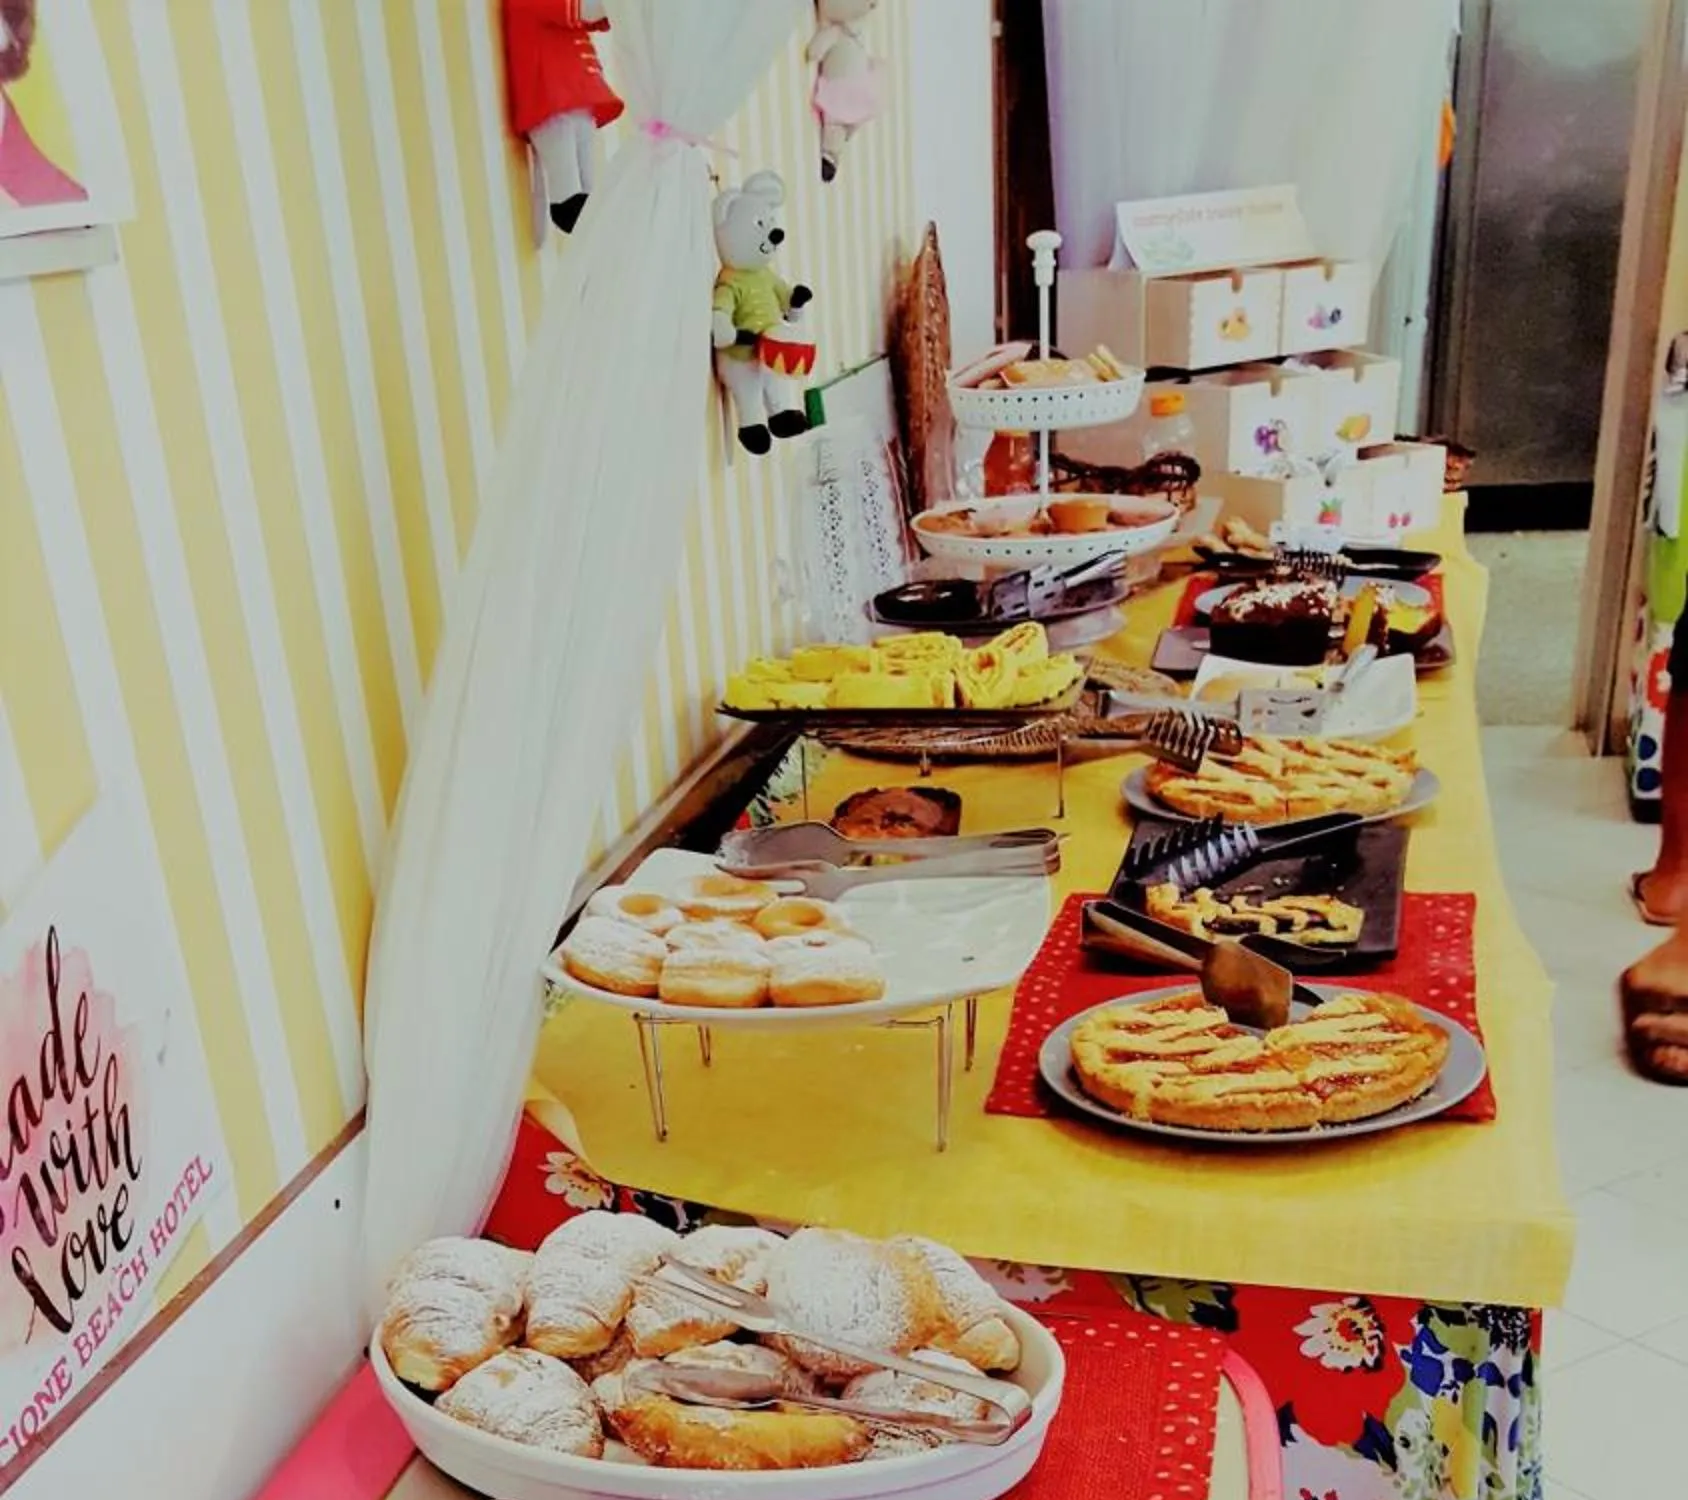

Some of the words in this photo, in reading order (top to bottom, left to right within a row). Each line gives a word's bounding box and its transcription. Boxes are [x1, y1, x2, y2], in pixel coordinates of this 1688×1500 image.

[0, 925, 101, 1181] ade
[13, 1052, 142, 1248] with
[150, 1154, 214, 1257] HOTEL
[12, 1183, 135, 1345] love
